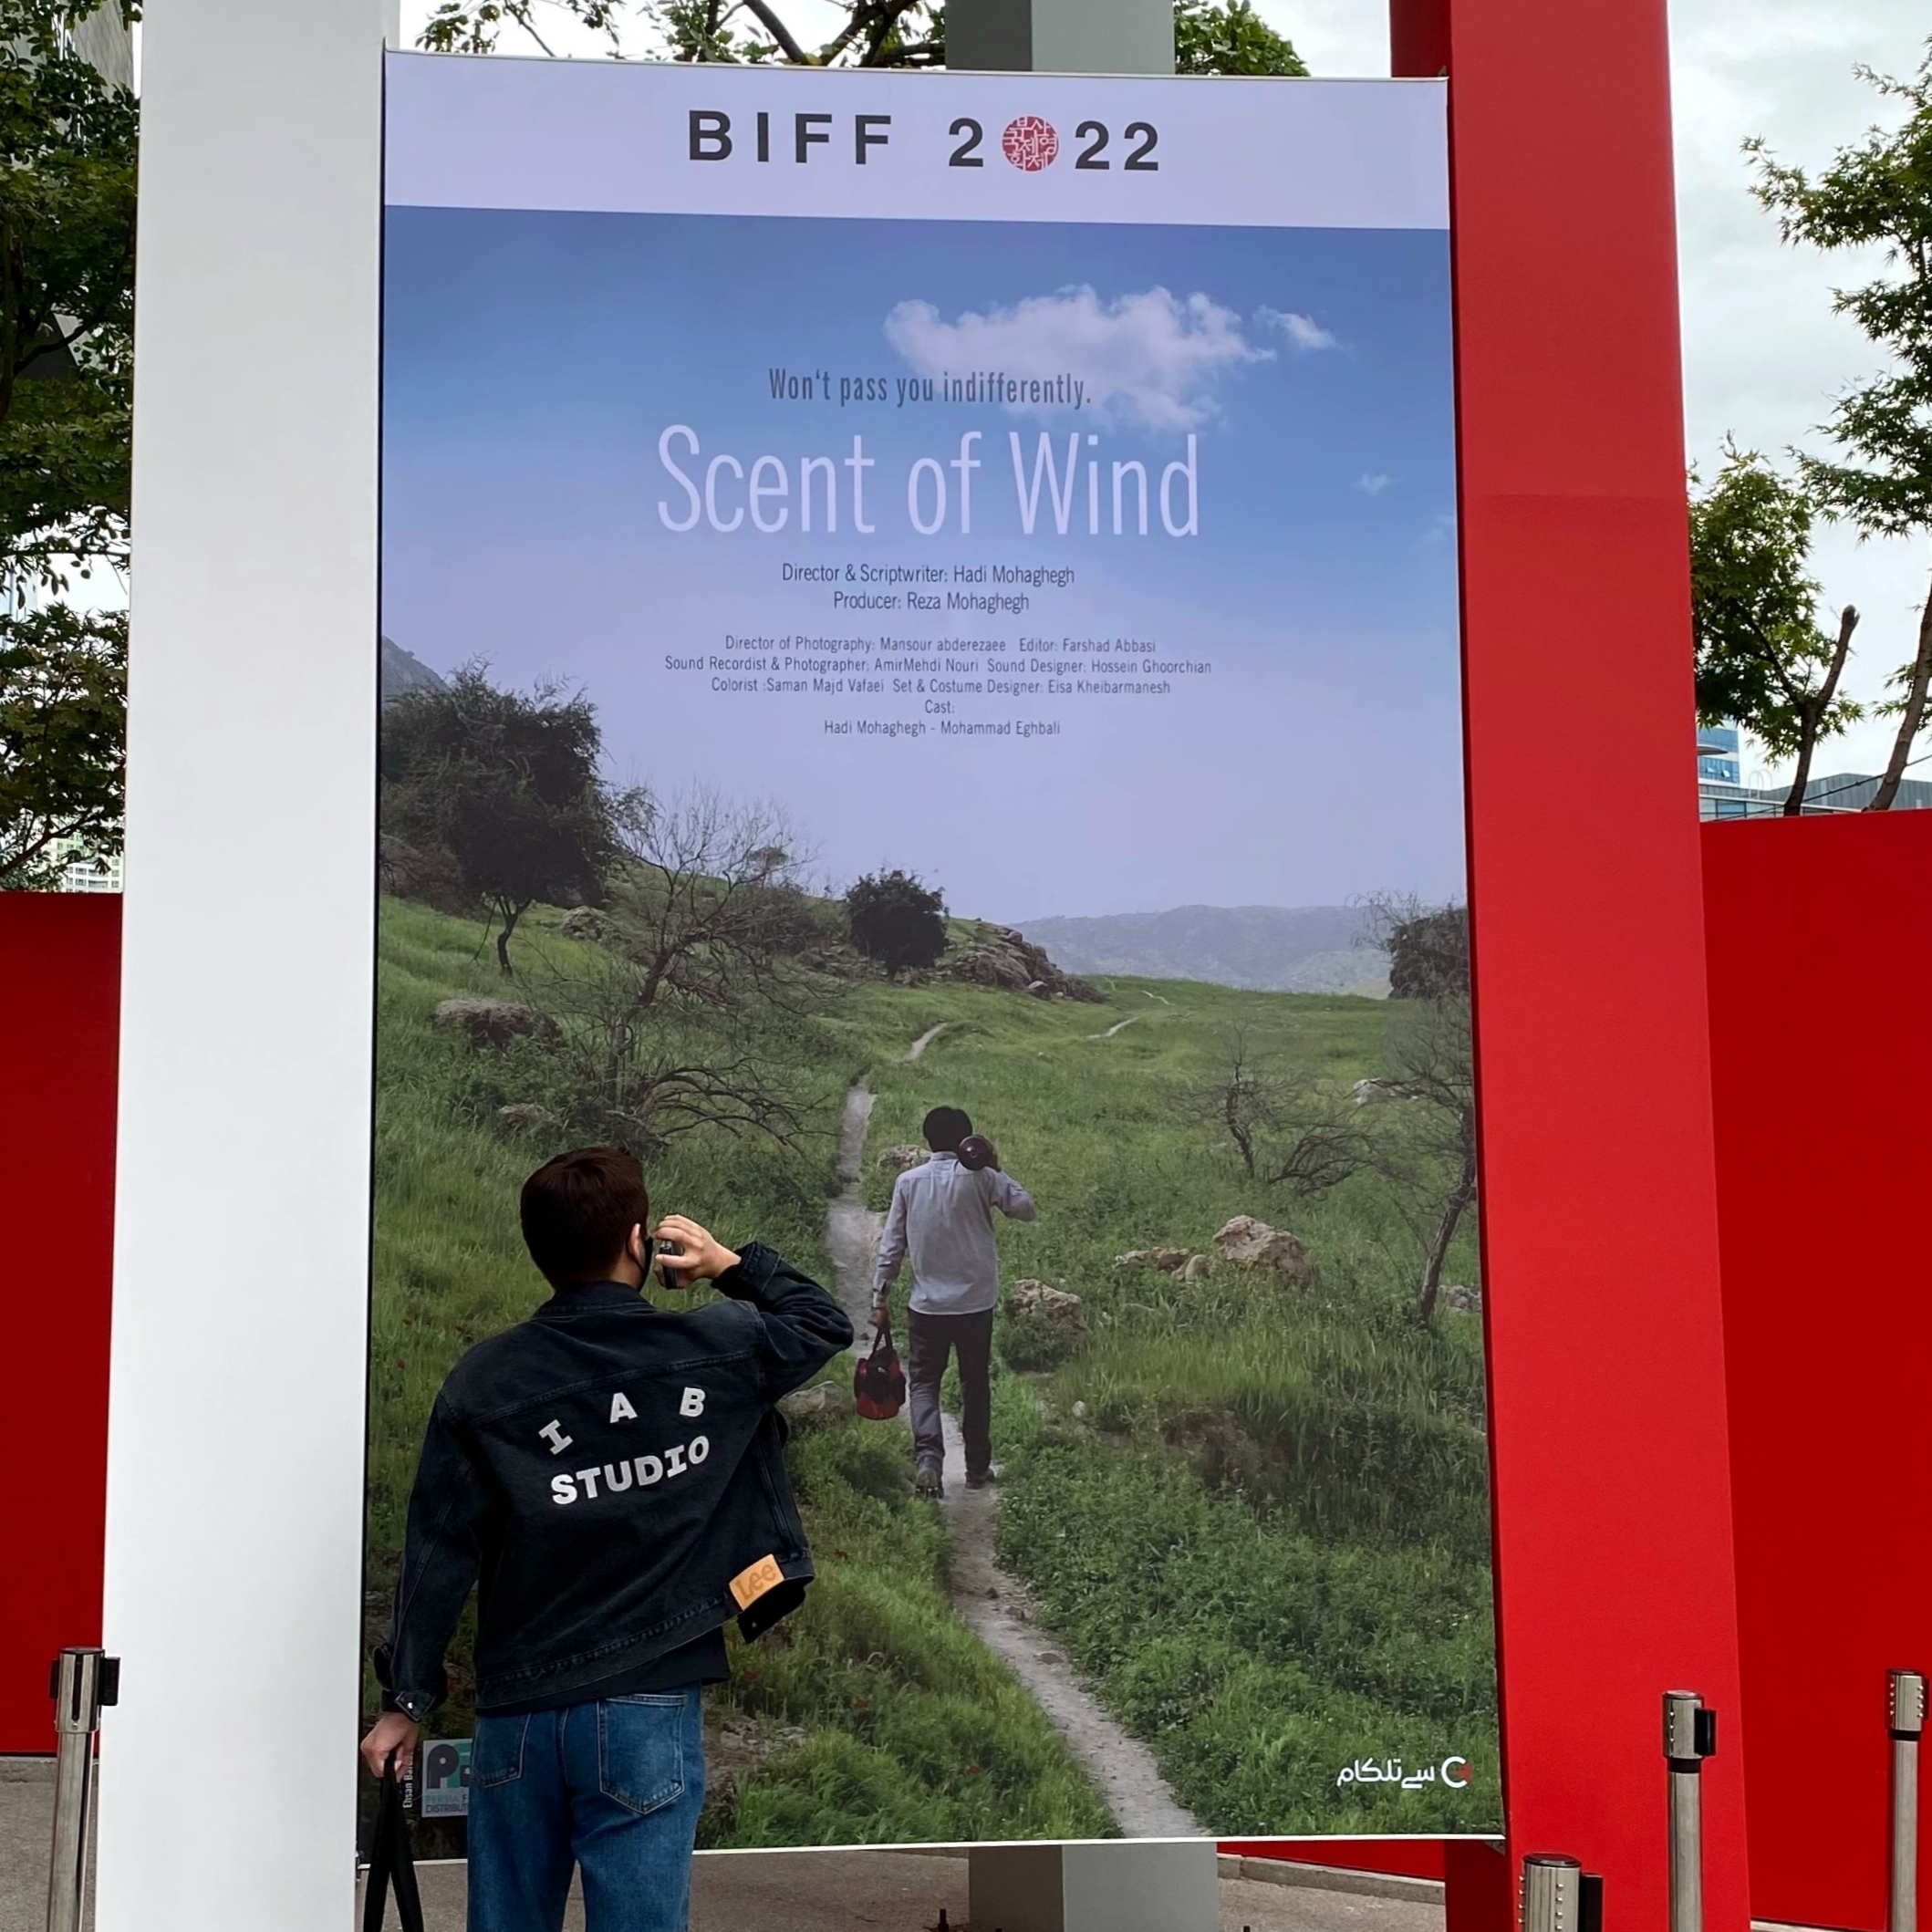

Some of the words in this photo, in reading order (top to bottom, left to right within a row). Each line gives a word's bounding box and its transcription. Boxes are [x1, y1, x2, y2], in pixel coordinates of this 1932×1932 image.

[689, 110, 892, 165] BIFF
[840, 374, 888, 407] pass
[897, 376, 934, 409] you
[943, 371, 1092, 410] indifferently.
[657, 424, 876, 534] Scent
[909, 431, 982, 535] of
[1008, 431, 1199, 537] Wind
[782, 563, 840, 581] Director
[845, 565, 857, 582] &
[860, 565, 949, 586] Scriptwriter:
[953, 565, 987, 583] Hadi
[992, 566, 1075, 587] Mohaghegh
[834, 591, 901, 609] Producer:
[907, 592, 941, 609] Reza
[947, 592, 1029, 614] Mohaghegh
[725, 635, 774, 650] Director
[779, 636, 791, 650] of
[795, 636, 876, 654] Photography:
[880, 637, 932, 651] Mansour
[937, 638, 1006, 652] abderezaee
[1019, 638, 1058, 653] Editor:
[1063, 638, 1110, 653] Farshad
[1115, 638, 1156, 653] Abbasi
[665, 656, 704, 670] Sound
[709, 656, 767, 671] Recordist
[771, 657, 780, 670] &
[784, 657, 869, 674] Photographer:
[946, 658, 979, 673] Nouri
[987, 658, 1025, 673] Sound
[1030, 659, 1086, 676] Designer:
[1091, 659, 1138, 674] Hossein
[1142, 659, 1211, 674] Ghoorchian
[712, 677, 758, 691] Colorist
[813, 679, 843, 695] Majd
[847, 679, 885, 693] Vafaei
[892, 679, 912, 693] Set
[916, 680, 926, 693] &
[930, 679, 982, 693] Costume
[986, 680, 1044, 696] Designer:
[1048, 680, 1073, 694] Eisa
[1077, 680, 1171, 694] Kheibarmanesh
[925, 700, 955, 713] Cast:
[825, 720, 853, 734] Hadi
[857, 721, 927, 738] Mohaghegh
[940, 721, 1011, 735] Mohammad
[1015, 722, 1061, 737] Eghbali
[550, 1435, 710, 1505] STUDIO
[734, 1562, 776, 1602] Lee
[426, 1803, 468, 1813] DISTRIBUT
